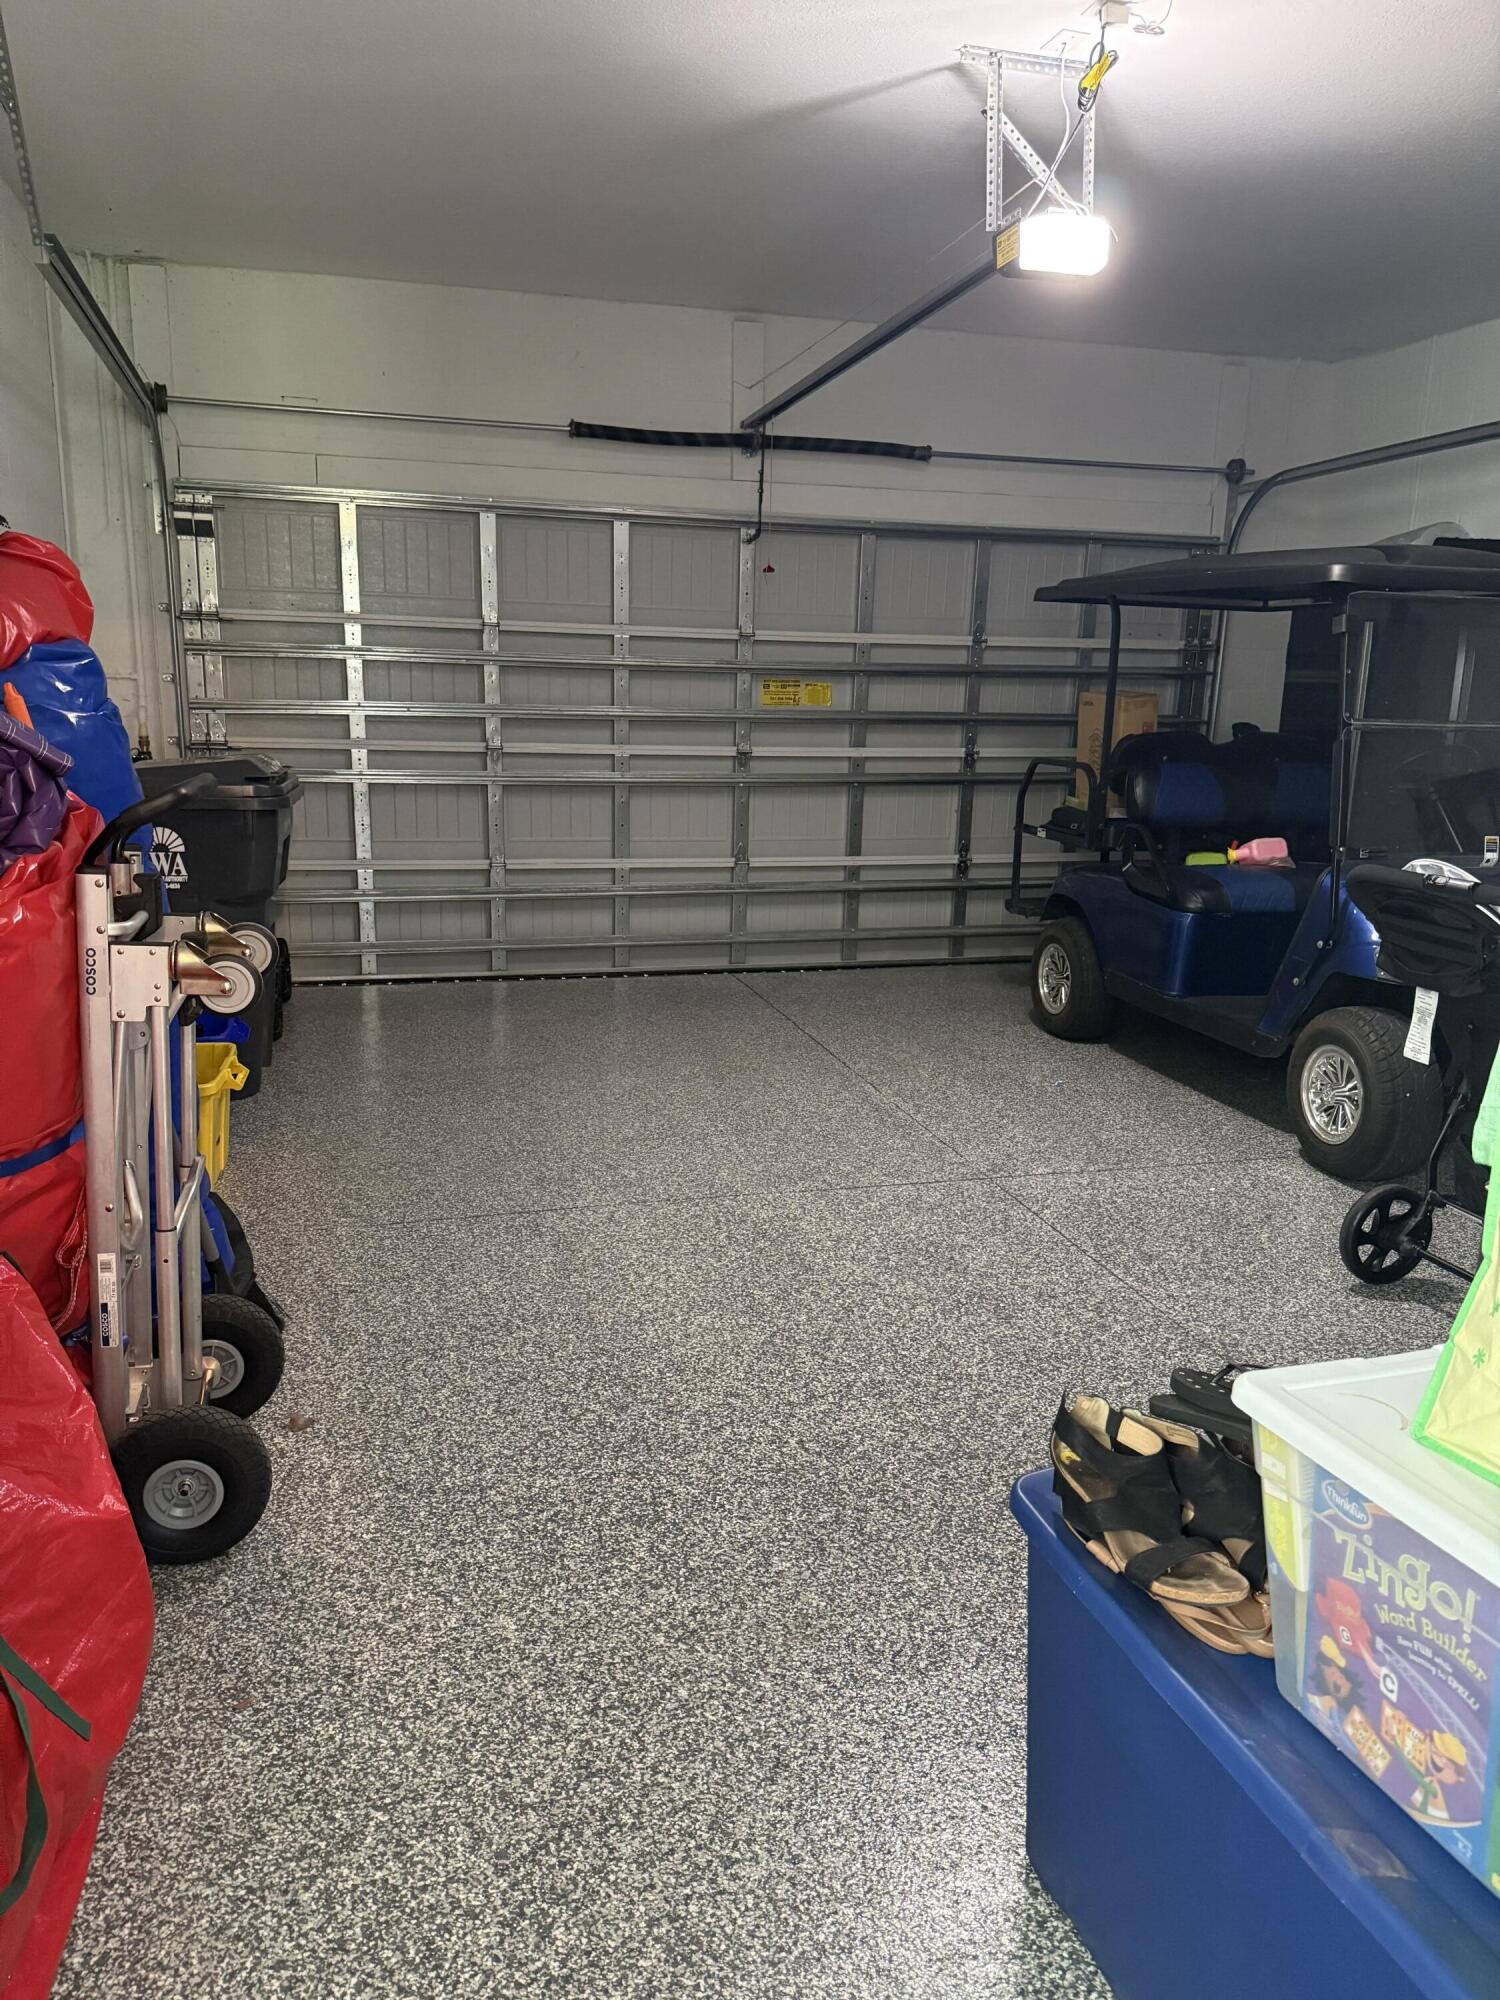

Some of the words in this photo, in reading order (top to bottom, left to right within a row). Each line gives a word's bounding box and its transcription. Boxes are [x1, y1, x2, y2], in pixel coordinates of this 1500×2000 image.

[86, 947, 97, 996] COSCO
[1335, 1530, 1476, 1644] Zingo!
[1374, 1604, 1417, 1632] Word
[1421, 1616, 1488, 1681] Builder
[1383, 1673, 1395, 1694] C
